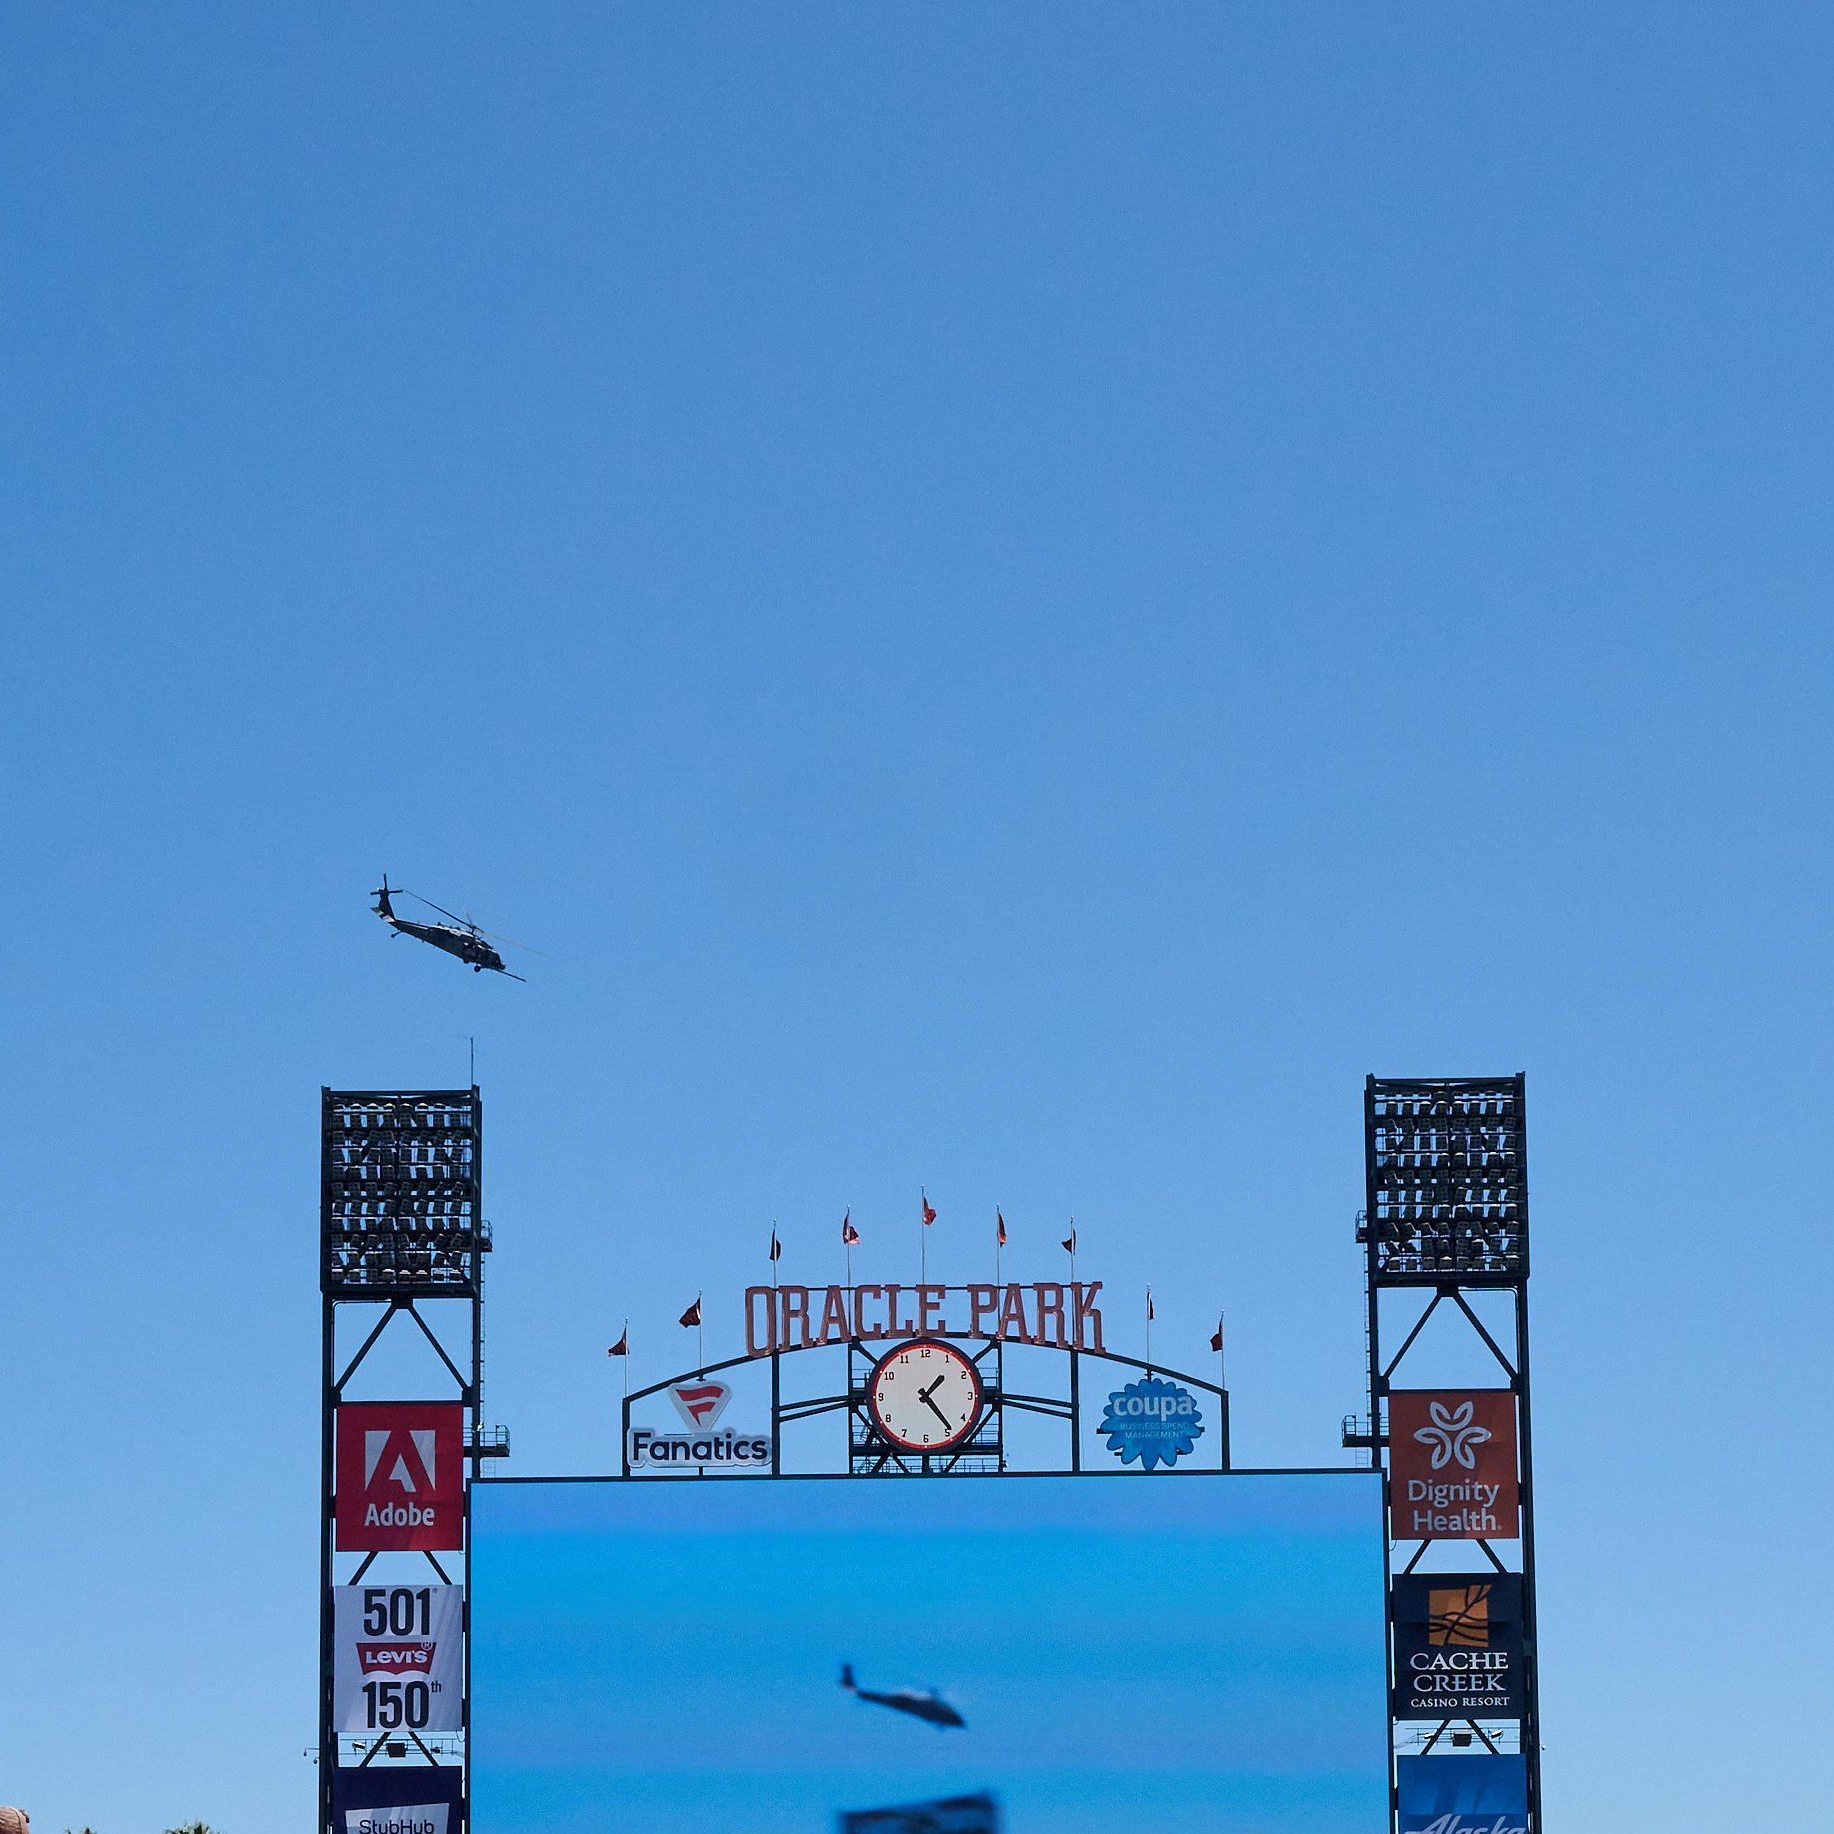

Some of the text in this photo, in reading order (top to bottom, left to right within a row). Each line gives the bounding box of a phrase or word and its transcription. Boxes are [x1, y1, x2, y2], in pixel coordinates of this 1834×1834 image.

[745, 1282, 1106, 1358] ORACLE PARK
[920, 1349, 931, 1358] 12
[900, 1355, 909, 1364] 11
[945, 1354, 950, 1364] 1
[884, 1371, 895, 1381] 10
[960, 1371, 967, 1380] 2
[878, 1393, 884, 1402] 9
[967, 1392, 973, 1401] 3
[1113, 1395, 1193, 1421] coupa
[885, 1414, 892, 1423] 8
[960, 1413, 966, 1422] 4
[901, 1429, 907, 1438] 7
[944, 1428, 951, 1437] 5
[923, 1434, 929, 1443] 6
[633, 1432, 767, 1461] Fanatics
[1408, 1479, 1499, 1508] Dignity
[364, 1502, 434, 1527] Adobe
[1414, 1508, 1496, 1531] Health
[363, 1588, 430, 1636] 501
[1410, 1653, 1509, 1671] CACHE
[1414, 1673, 1506, 1693] CREEK
[1411, 1698, 1510, 1708] CASINO RESORT
